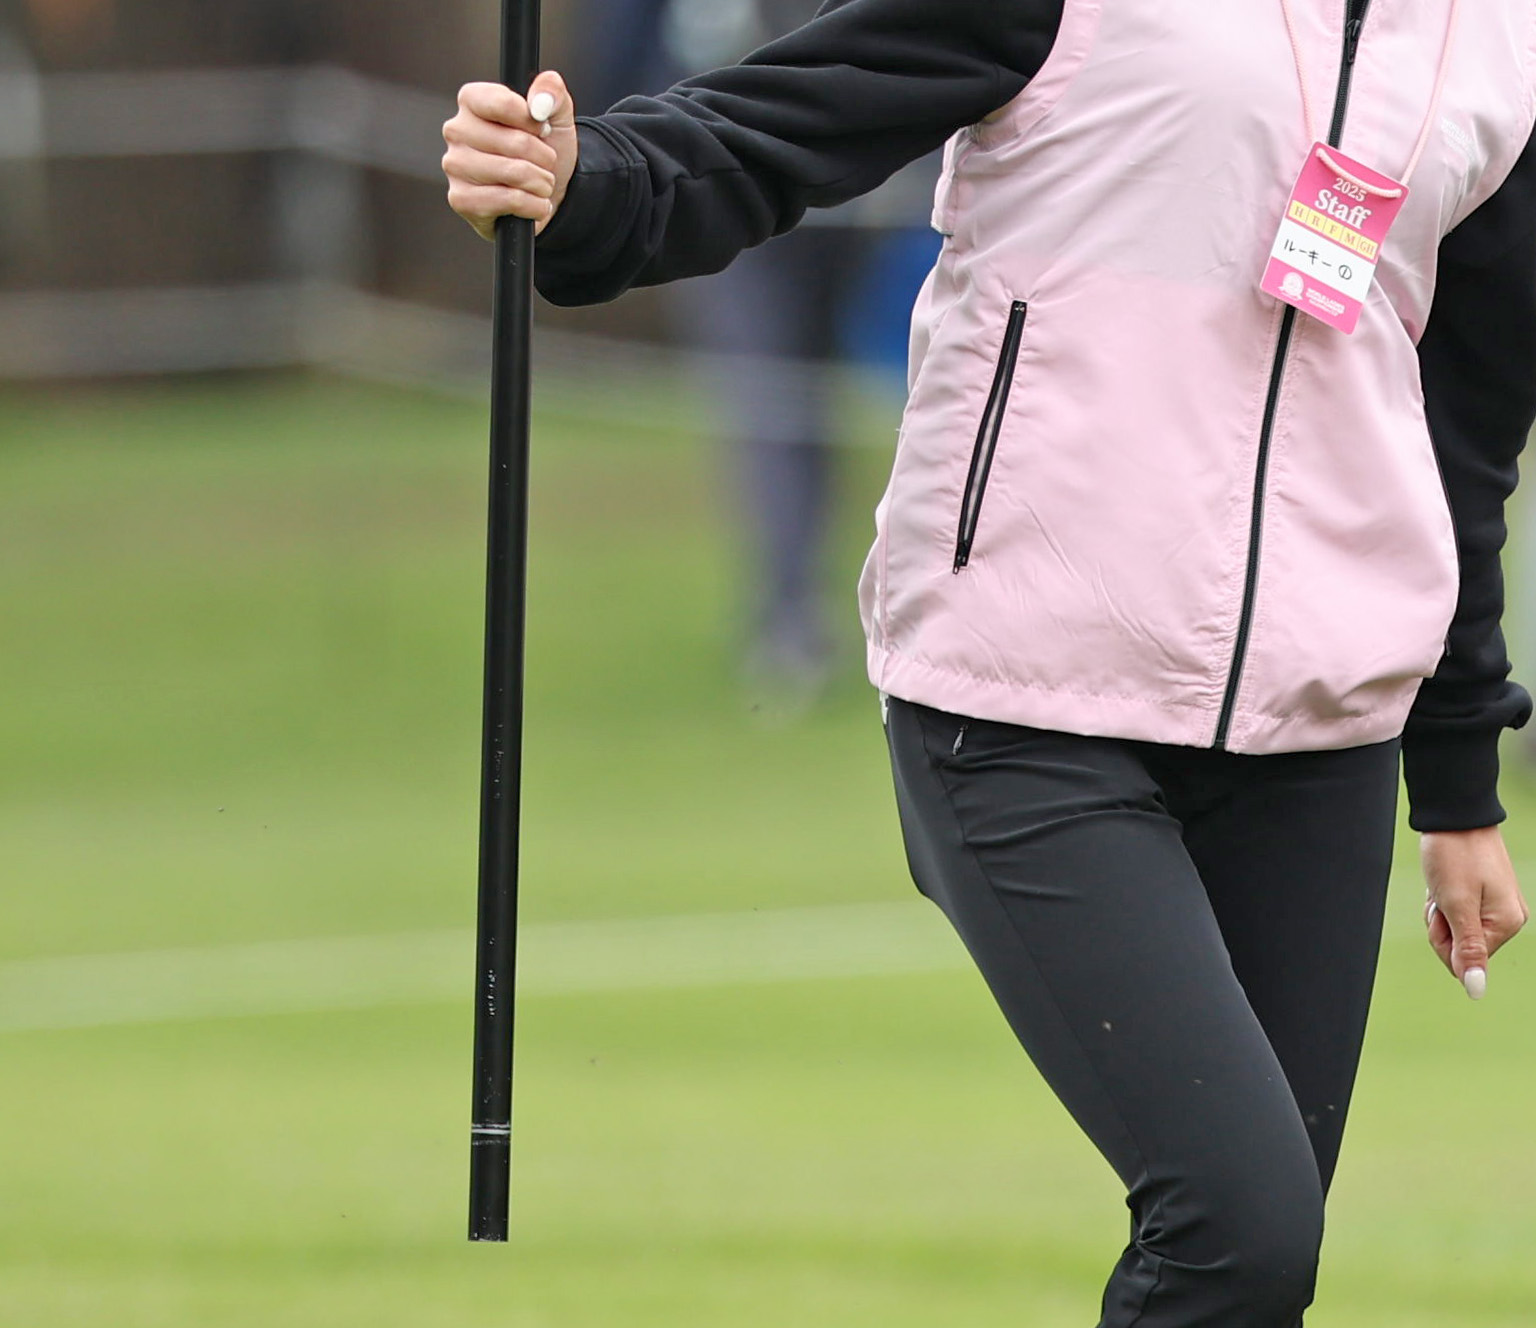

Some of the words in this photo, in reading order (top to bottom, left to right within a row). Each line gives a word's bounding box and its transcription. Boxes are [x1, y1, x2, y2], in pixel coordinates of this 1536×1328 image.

[1314, 189, 1372, 230] Staff
[1332, 177, 1367, 202] 2025
[1294, 205, 1304, 219] H
[1311, 214, 1321, 227] R
[1329, 223, 1338, 235] F
[1344, 231, 1356, 245] M
